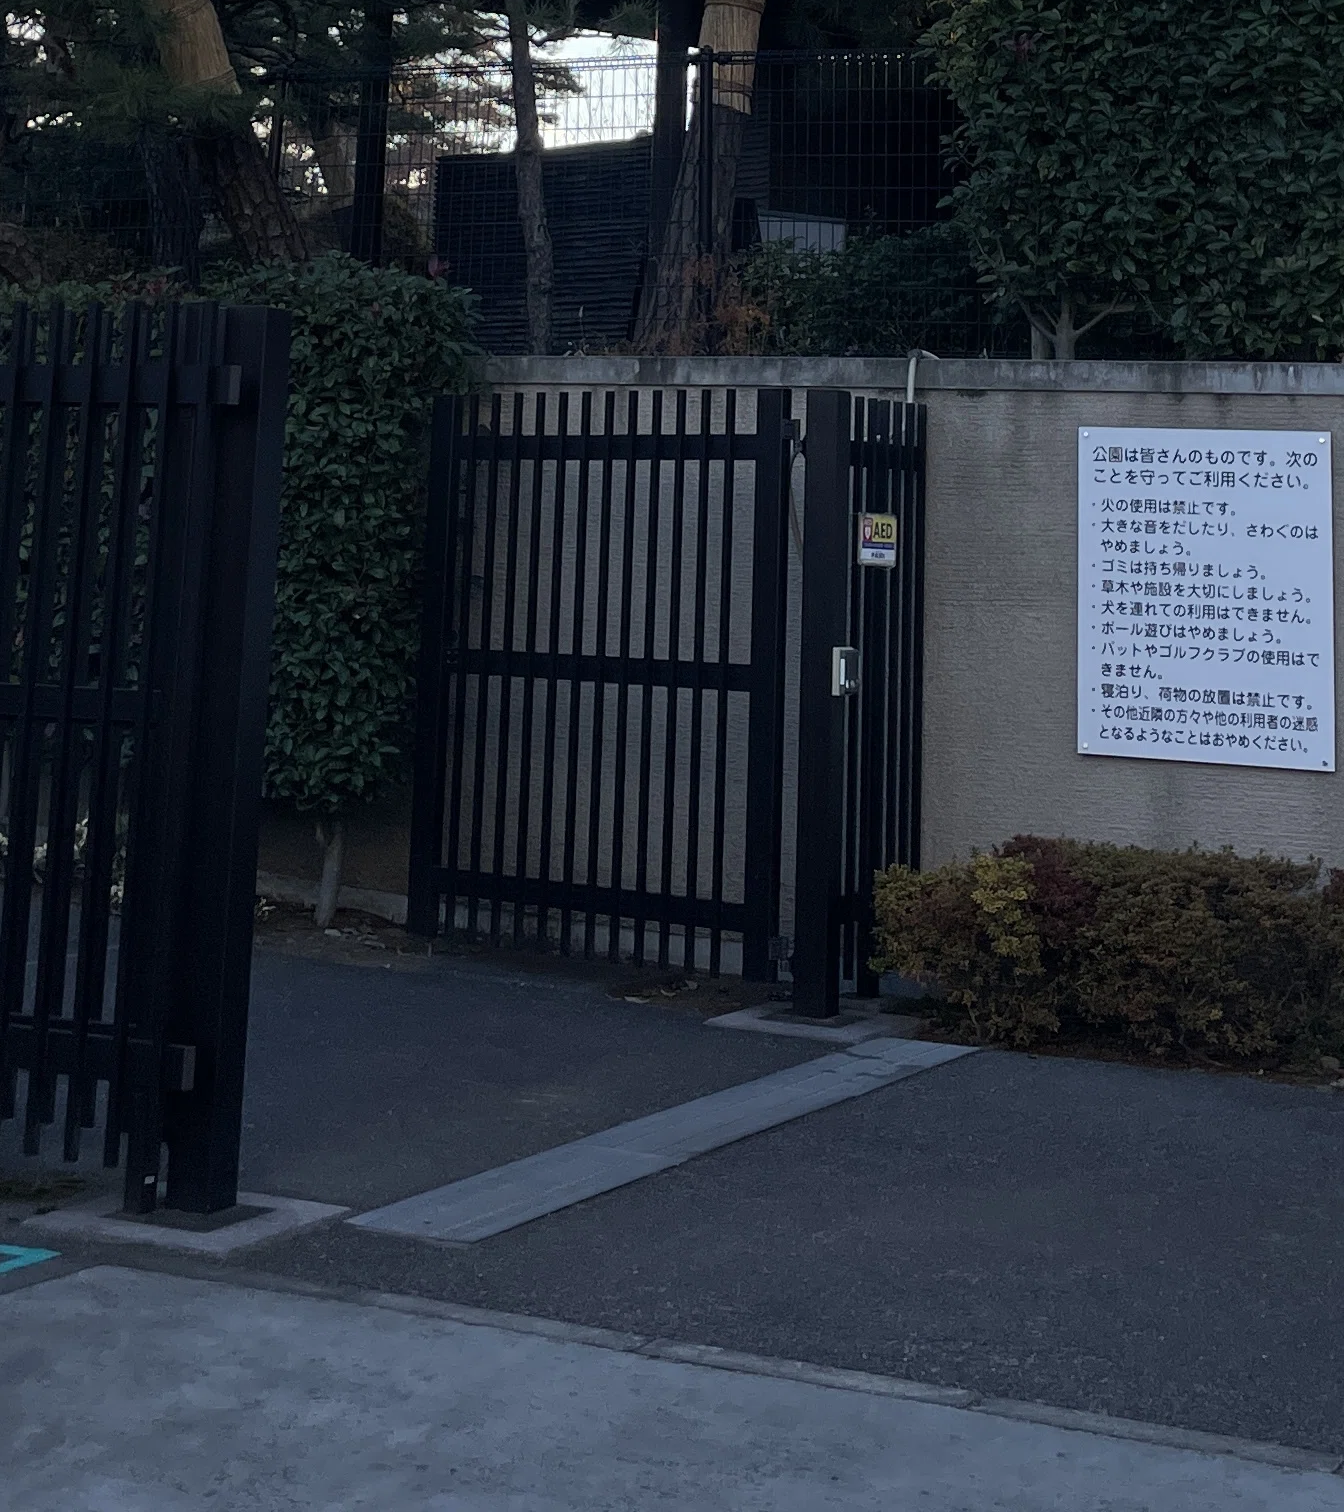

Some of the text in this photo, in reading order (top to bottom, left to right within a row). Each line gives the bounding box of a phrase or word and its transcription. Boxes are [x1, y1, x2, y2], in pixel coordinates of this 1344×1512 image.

[1094, 469, 1308, 489] ことを守ってご利用ください。
[873, 521, 893, 539] AED
[1101, 539, 1190, 556] やめましょう。
[1102, 663, 1162, 679] きません。
[1100, 725, 1308, 753] となるようなことはおやめください。
